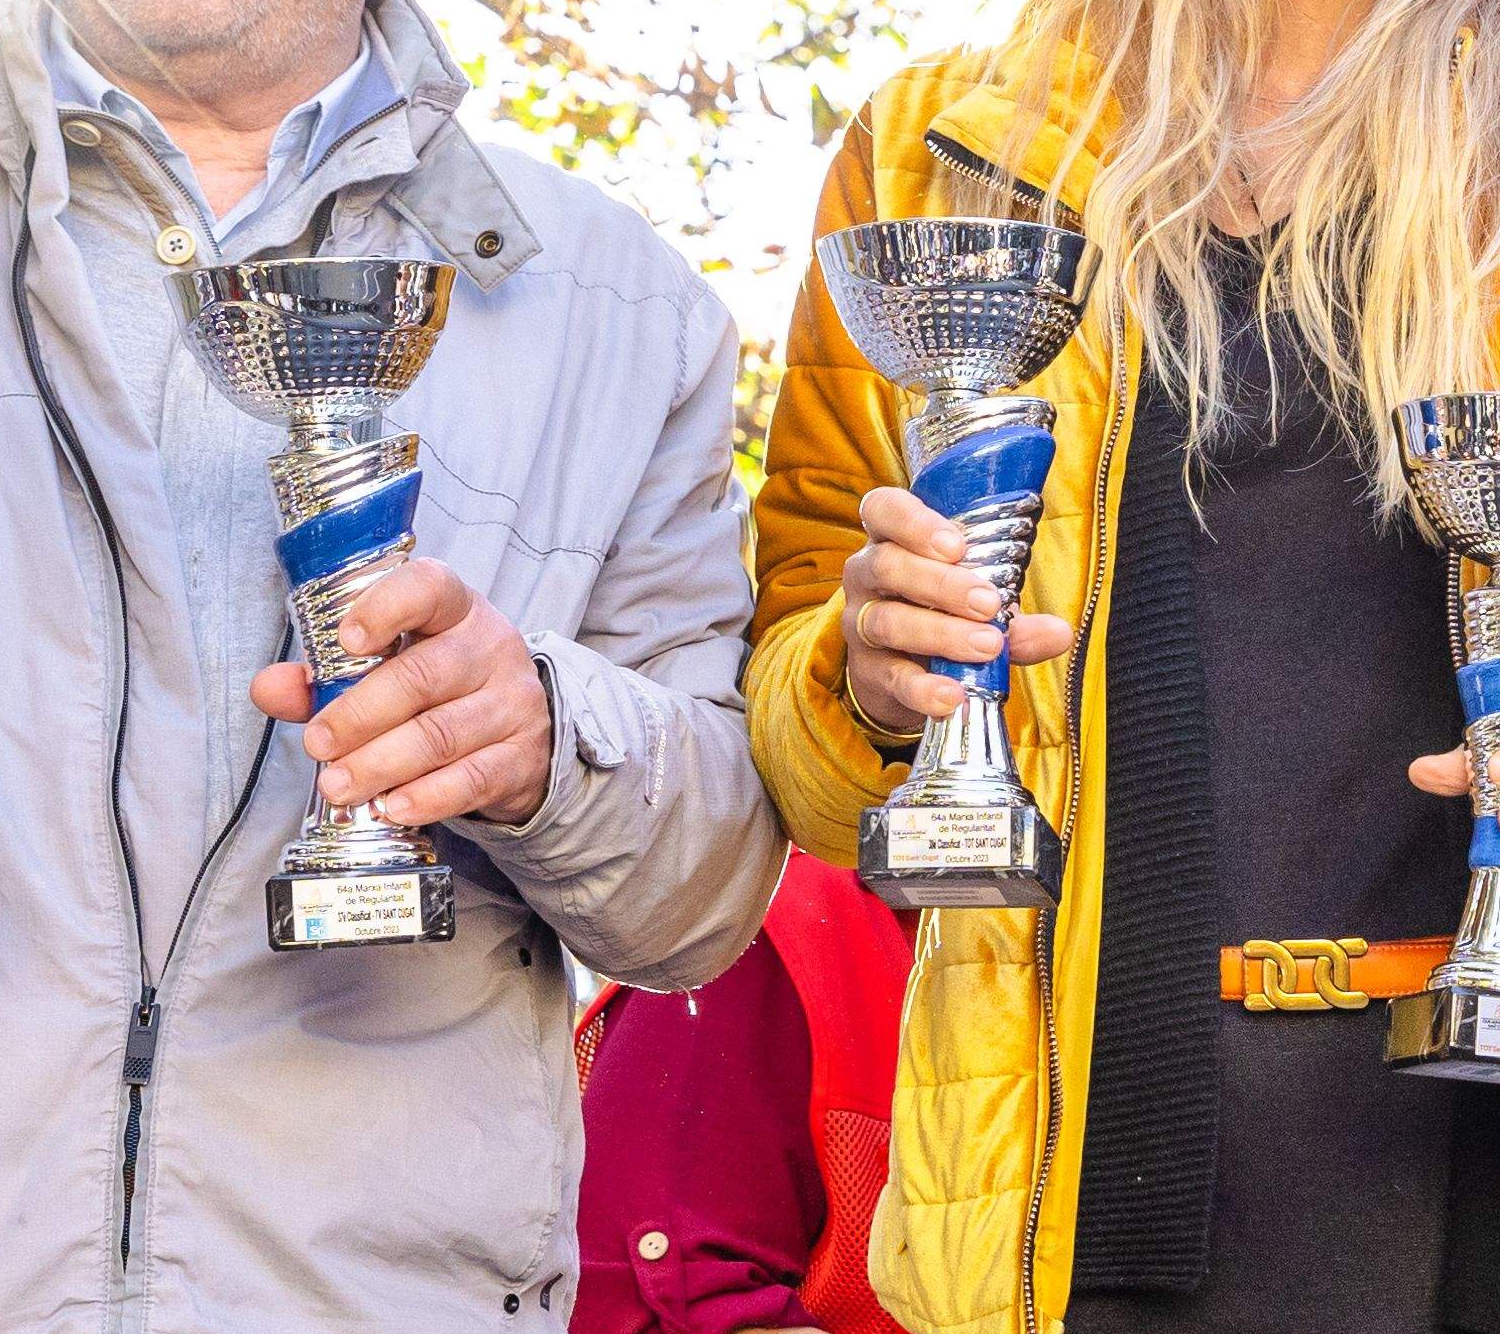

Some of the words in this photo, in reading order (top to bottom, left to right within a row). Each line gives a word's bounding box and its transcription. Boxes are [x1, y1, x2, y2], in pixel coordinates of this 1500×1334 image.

[977, 812, 1003, 820] Infantil
[952, 824, 995, 833] Regularitat
[976, 838, 989, 847] SANT
[990, 837, 1007, 847] CUGAT
[337, 886, 352, 894] 64a
[384, 881, 411, 890] Infantil
[359, 894, 404, 905] Regularitat
[383, 908, 396, 919] SANT
[398, 907, 414, 918] CUGAT
[355, 927, 380, 935] Octubre
[383, 925, 399, 934] 2023
